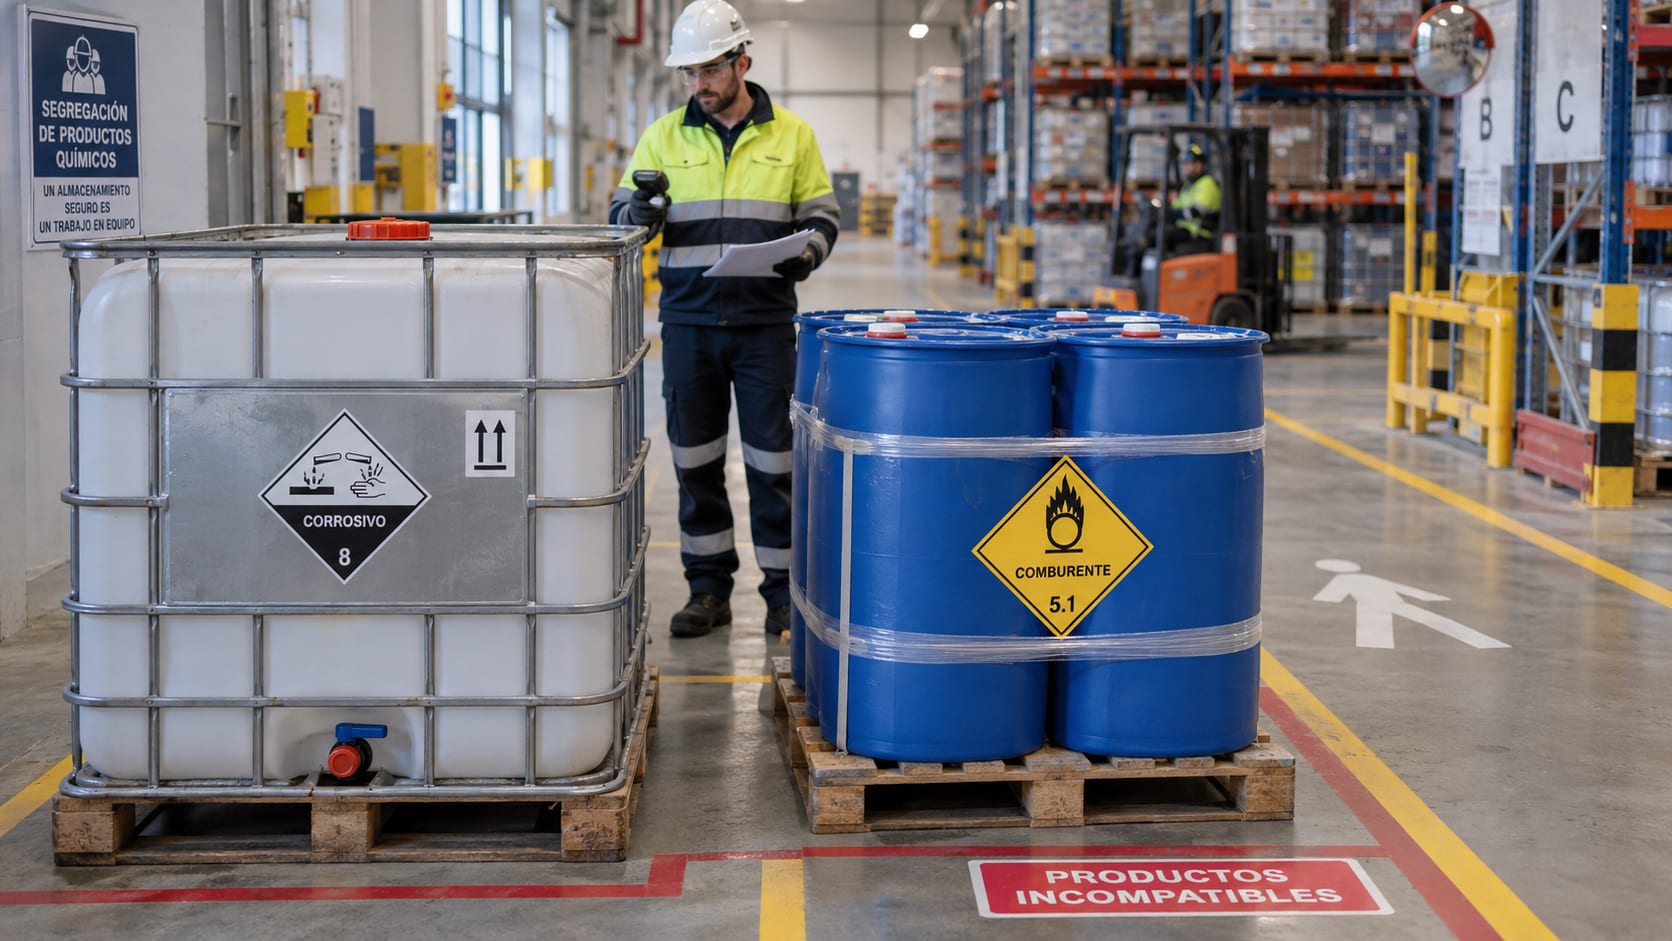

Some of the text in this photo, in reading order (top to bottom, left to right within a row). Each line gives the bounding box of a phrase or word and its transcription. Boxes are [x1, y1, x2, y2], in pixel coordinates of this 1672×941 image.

[42, 100, 128, 121] SEGREGACIÓN
[1557, 81, 1574, 132] C
[1481, 98, 1493, 140] B
[39, 125, 132, 145] DE PRODUCTOS
[56, 147, 117, 169] QUÍMICOS
[43, 184, 131, 197] UN ALMACENAMIENTO
[64, 202, 111, 214] SEGURO ES
[39, 218, 135, 233] UN TRABAJO EN EQUIPO
[303, 515, 386, 527] CORROSIVO
[338, 547, 351, 566] 8
[1015, 564, 1111, 579] COMBURENTE
[1049, 595, 1075, 613] 5.1
[1046, 869, 1289, 883] PRODUCTOS
[1016, 888, 1343, 905] INCOMPATIBLES
